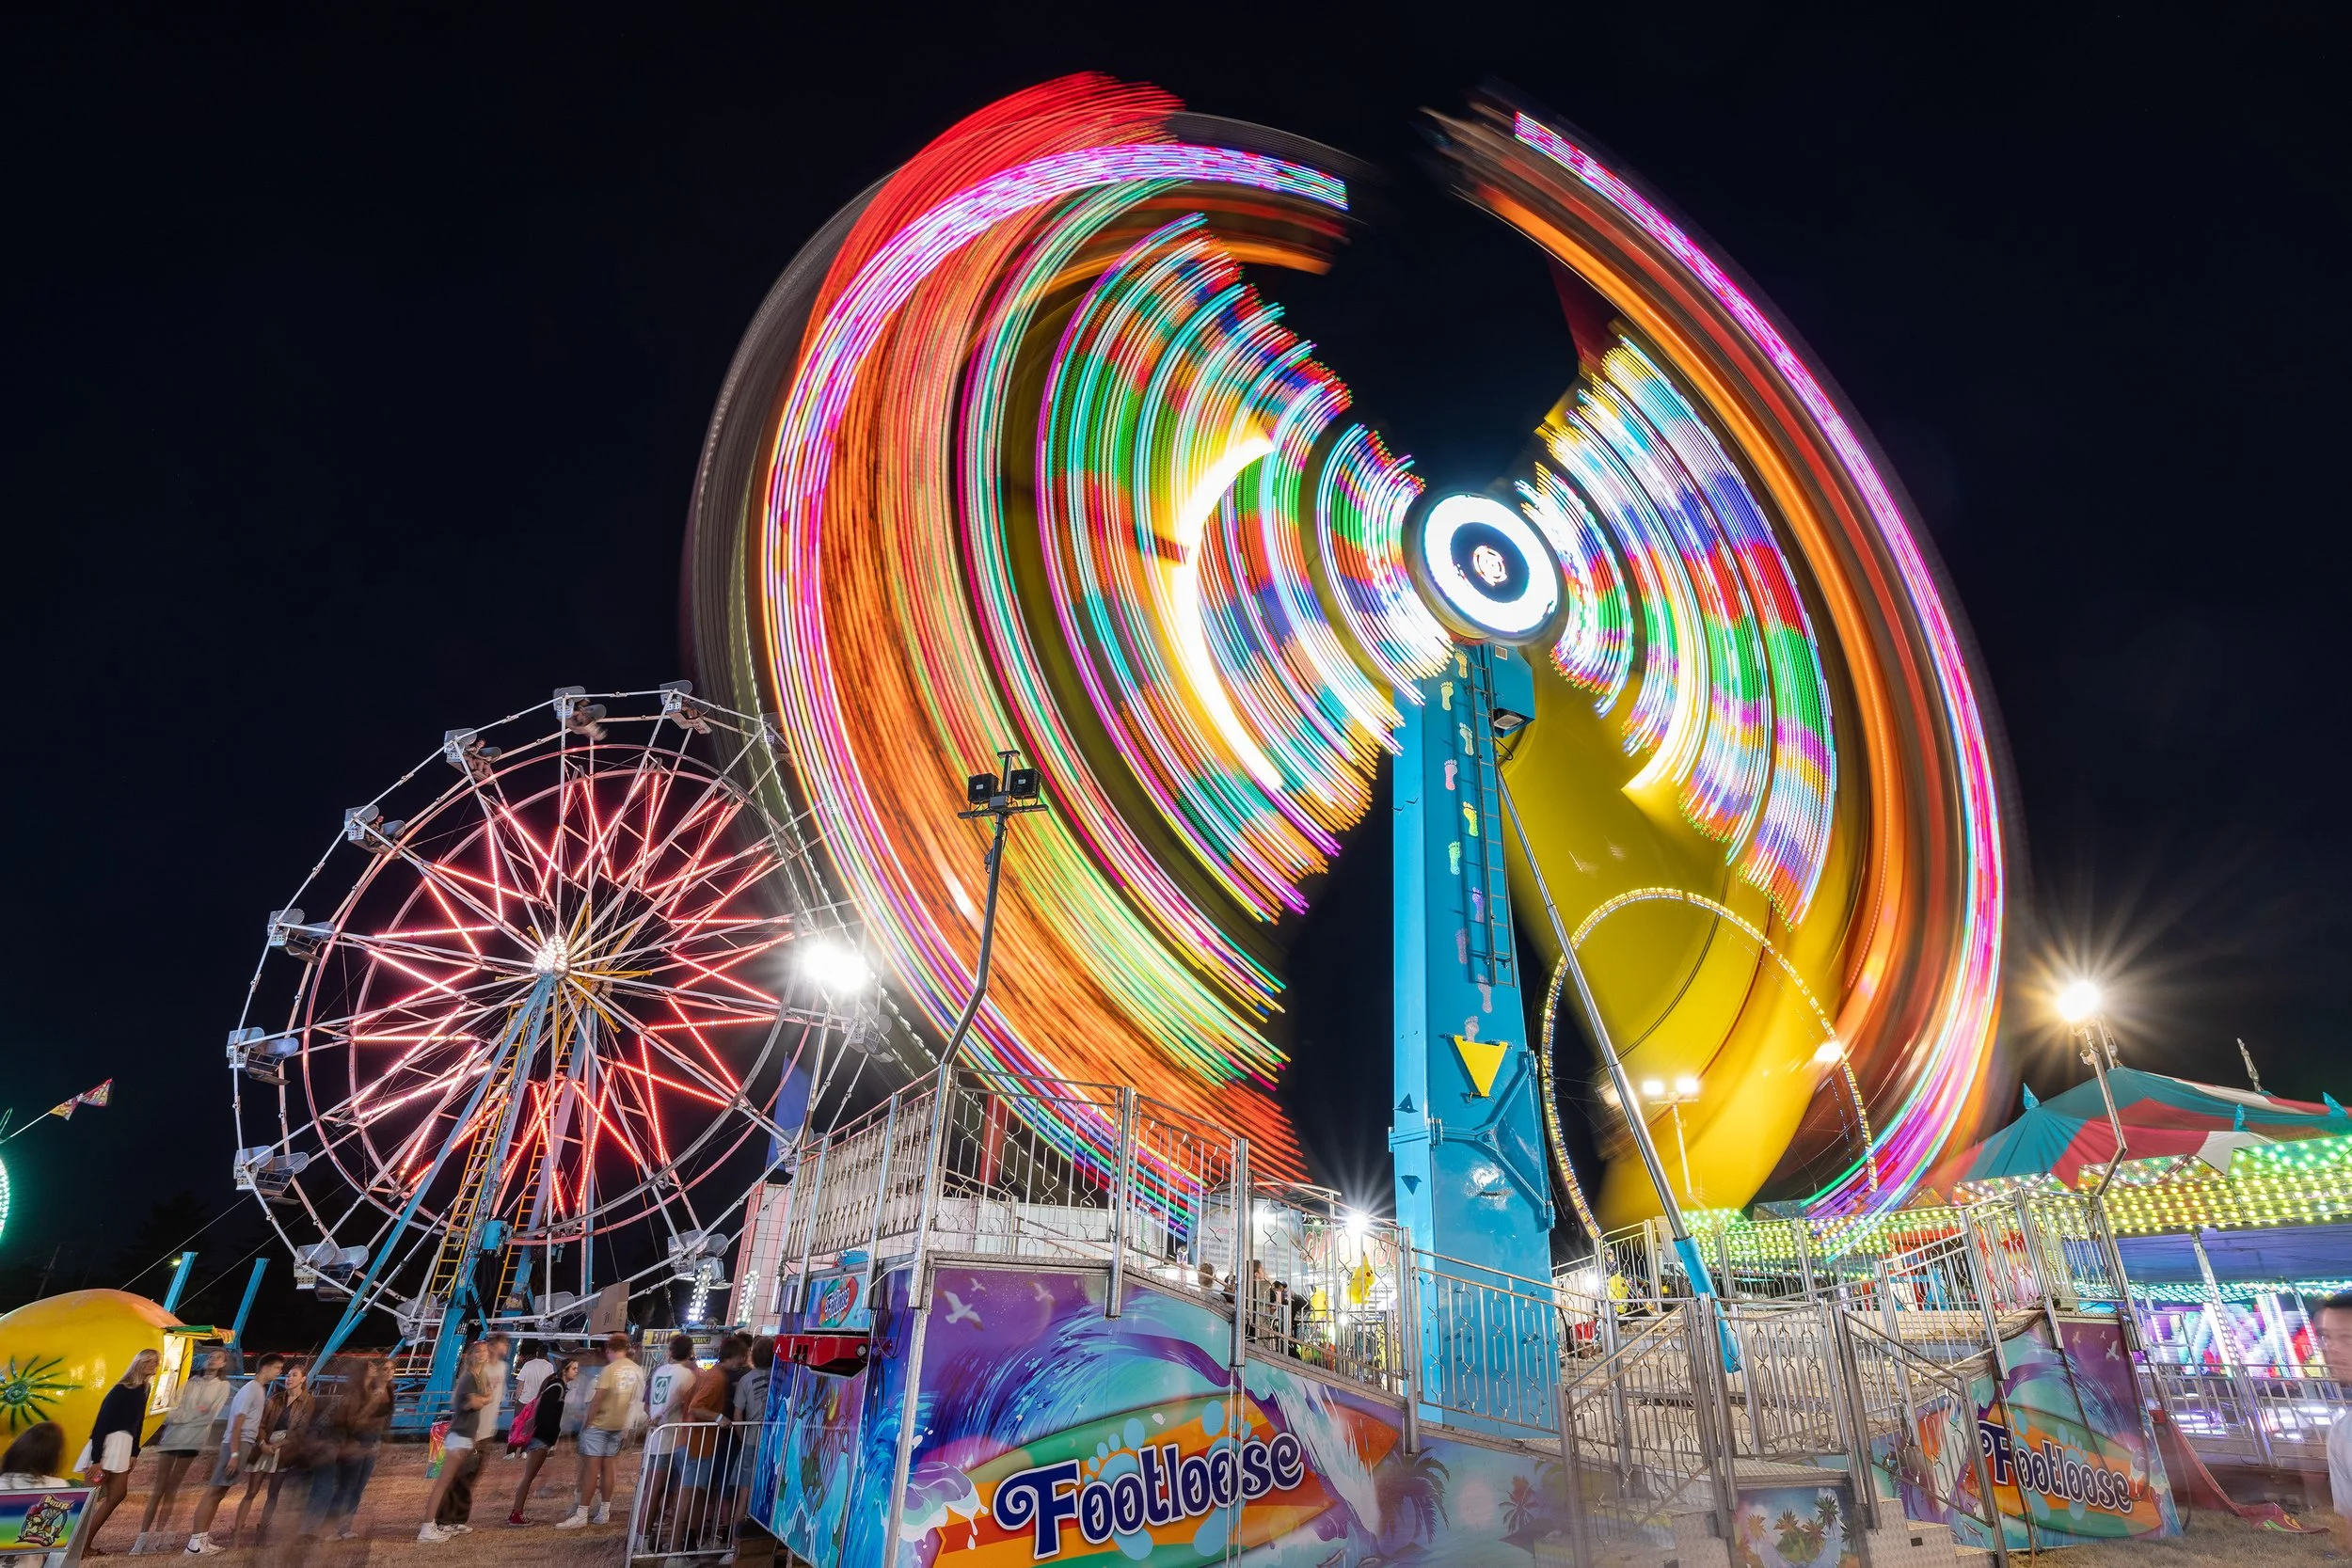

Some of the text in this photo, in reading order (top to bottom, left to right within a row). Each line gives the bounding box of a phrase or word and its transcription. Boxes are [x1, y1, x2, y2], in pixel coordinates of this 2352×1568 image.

[651, 1330, 671, 1344] EXIT
[993, 1433, 1304, 1560] Footloose
[1978, 1420, 2133, 1513] Footloose
